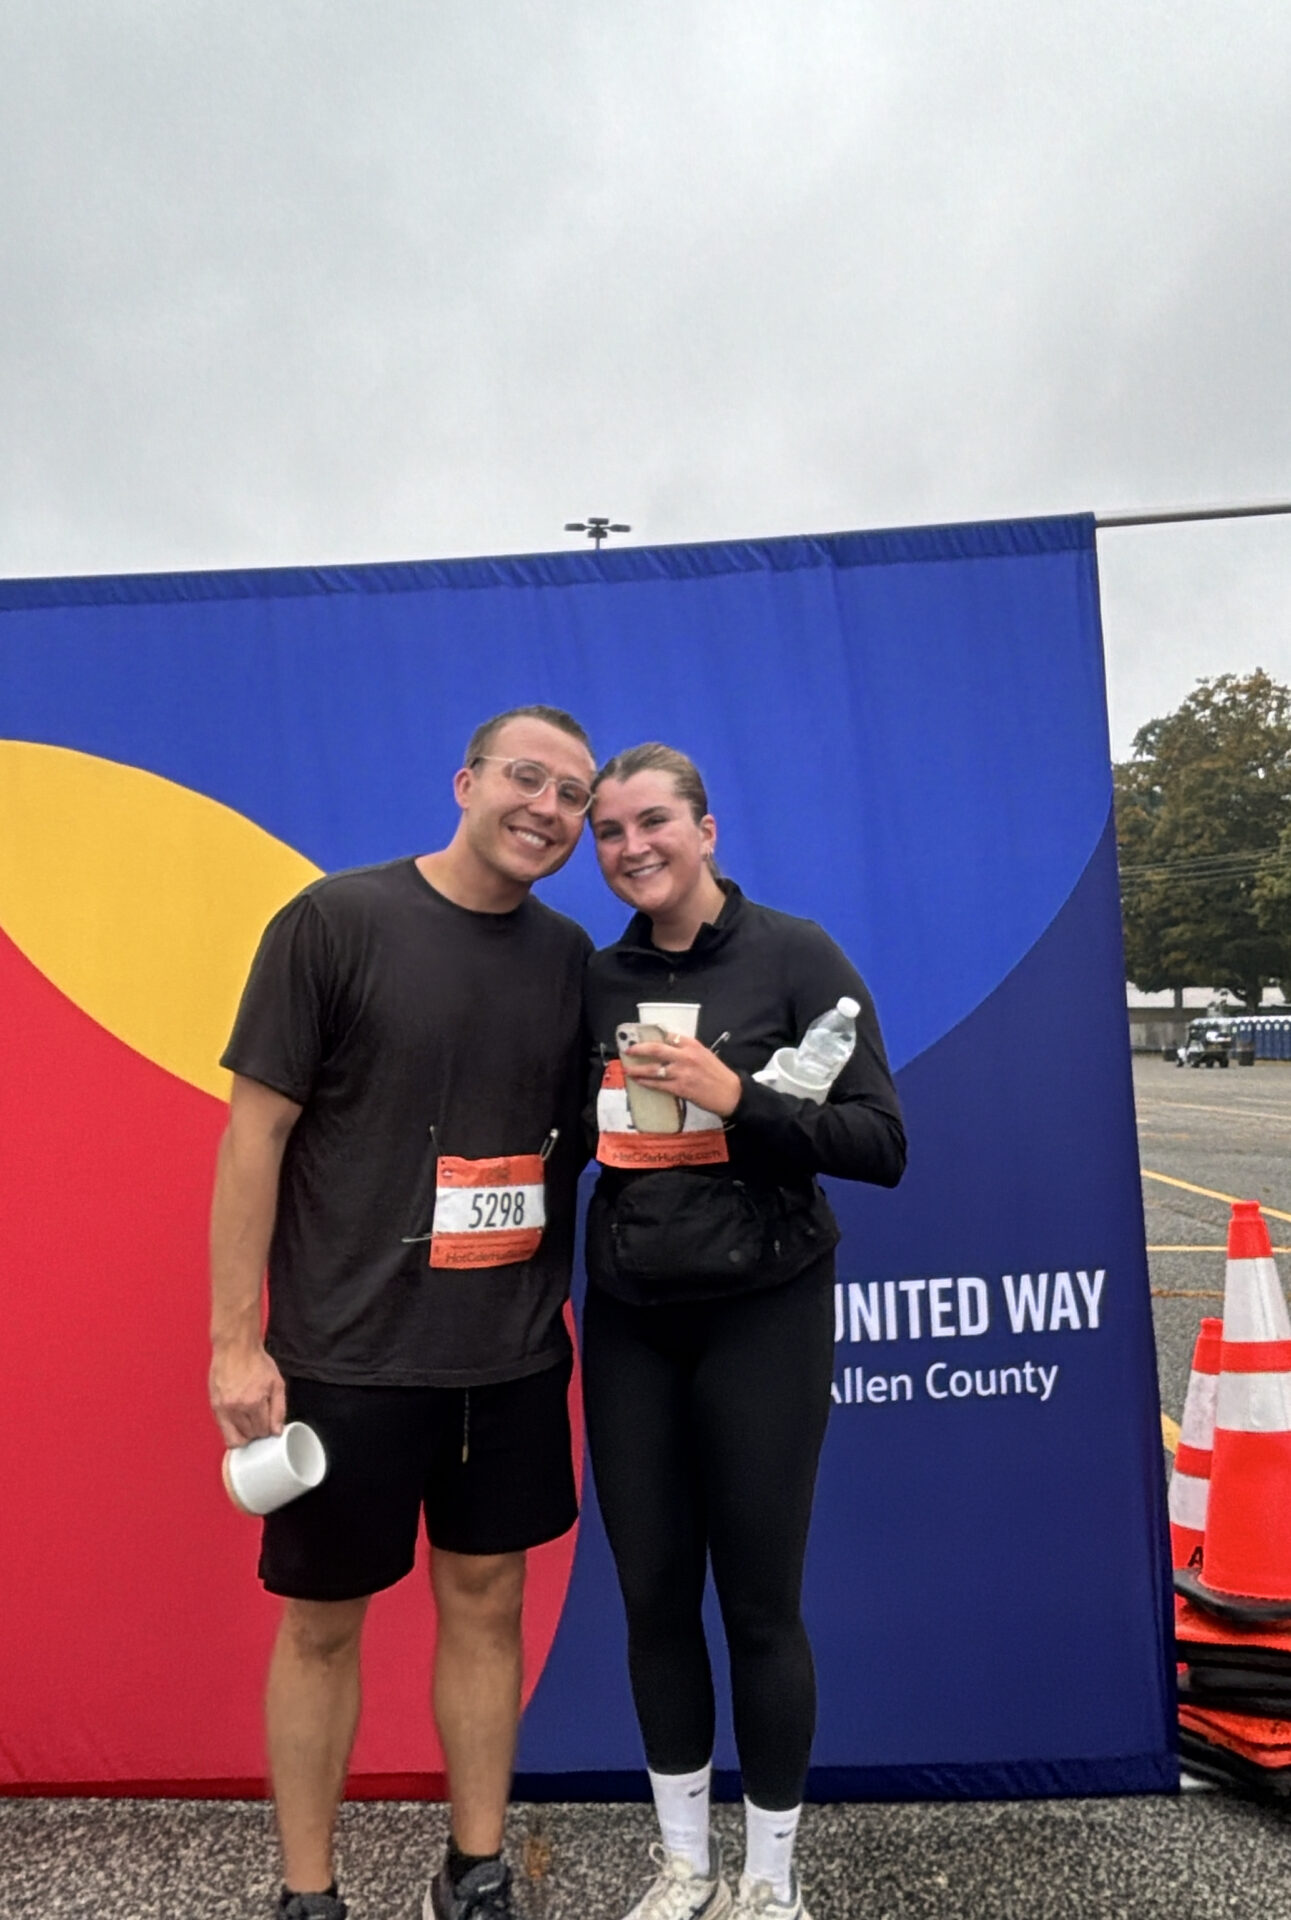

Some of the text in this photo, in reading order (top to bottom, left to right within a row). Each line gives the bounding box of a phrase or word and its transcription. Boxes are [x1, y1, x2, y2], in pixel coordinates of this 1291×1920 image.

[468, 1191, 525, 1228] 5298
[1002, 1269, 1106, 1334] WAY
[925, 1360, 1059, 1402] County
